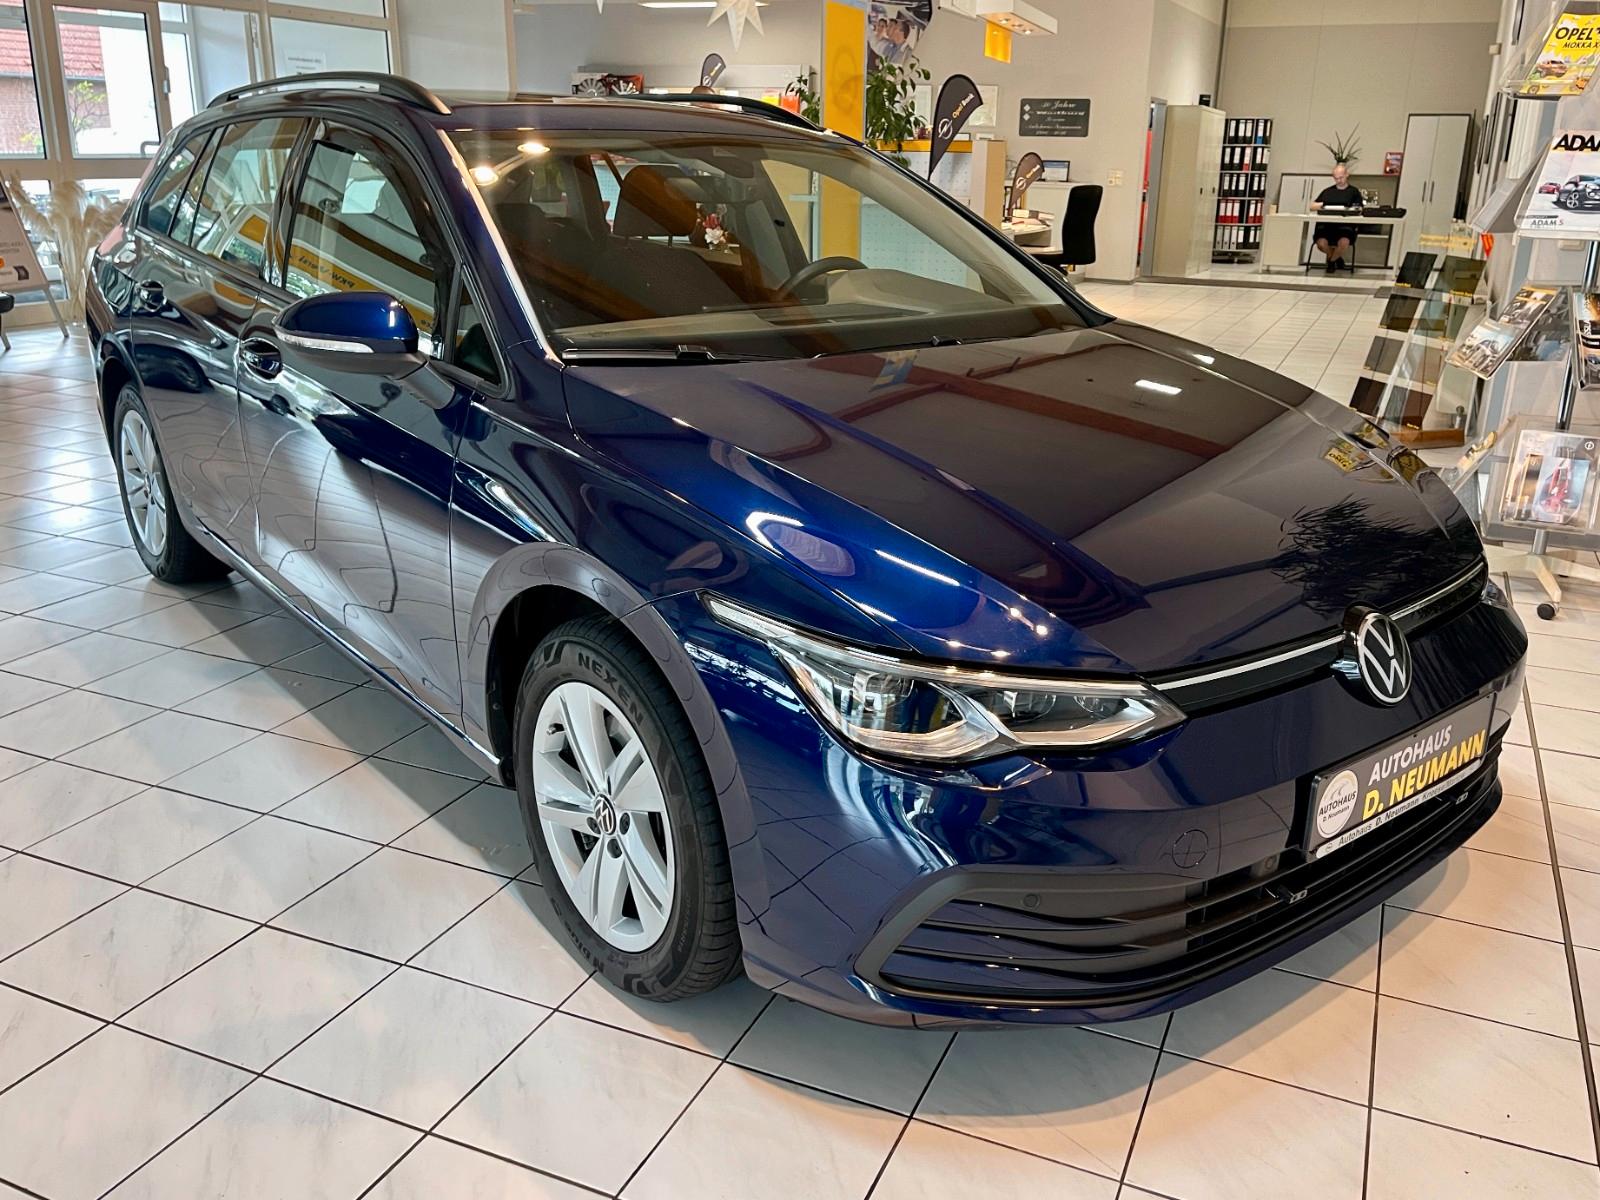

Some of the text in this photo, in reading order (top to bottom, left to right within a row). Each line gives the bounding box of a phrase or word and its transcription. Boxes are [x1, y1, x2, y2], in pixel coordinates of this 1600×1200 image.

[1555, 27, 1594, 41] OPEL
[1552, 133, 1600, 152] ADA
[578, 652, 644, 727] NEXEN
[1362, 789, 1385, 821] D.
[1389, 729, 1487, 806] NEUMANN
[1368, 724, 1453, 787] AUTOHAUS
[1318, 790, 1357, 816] AUTOHAUS
[1338, 823, 1373, 845] Autohaus
[1384, 797, 1420, 821] Neumann
